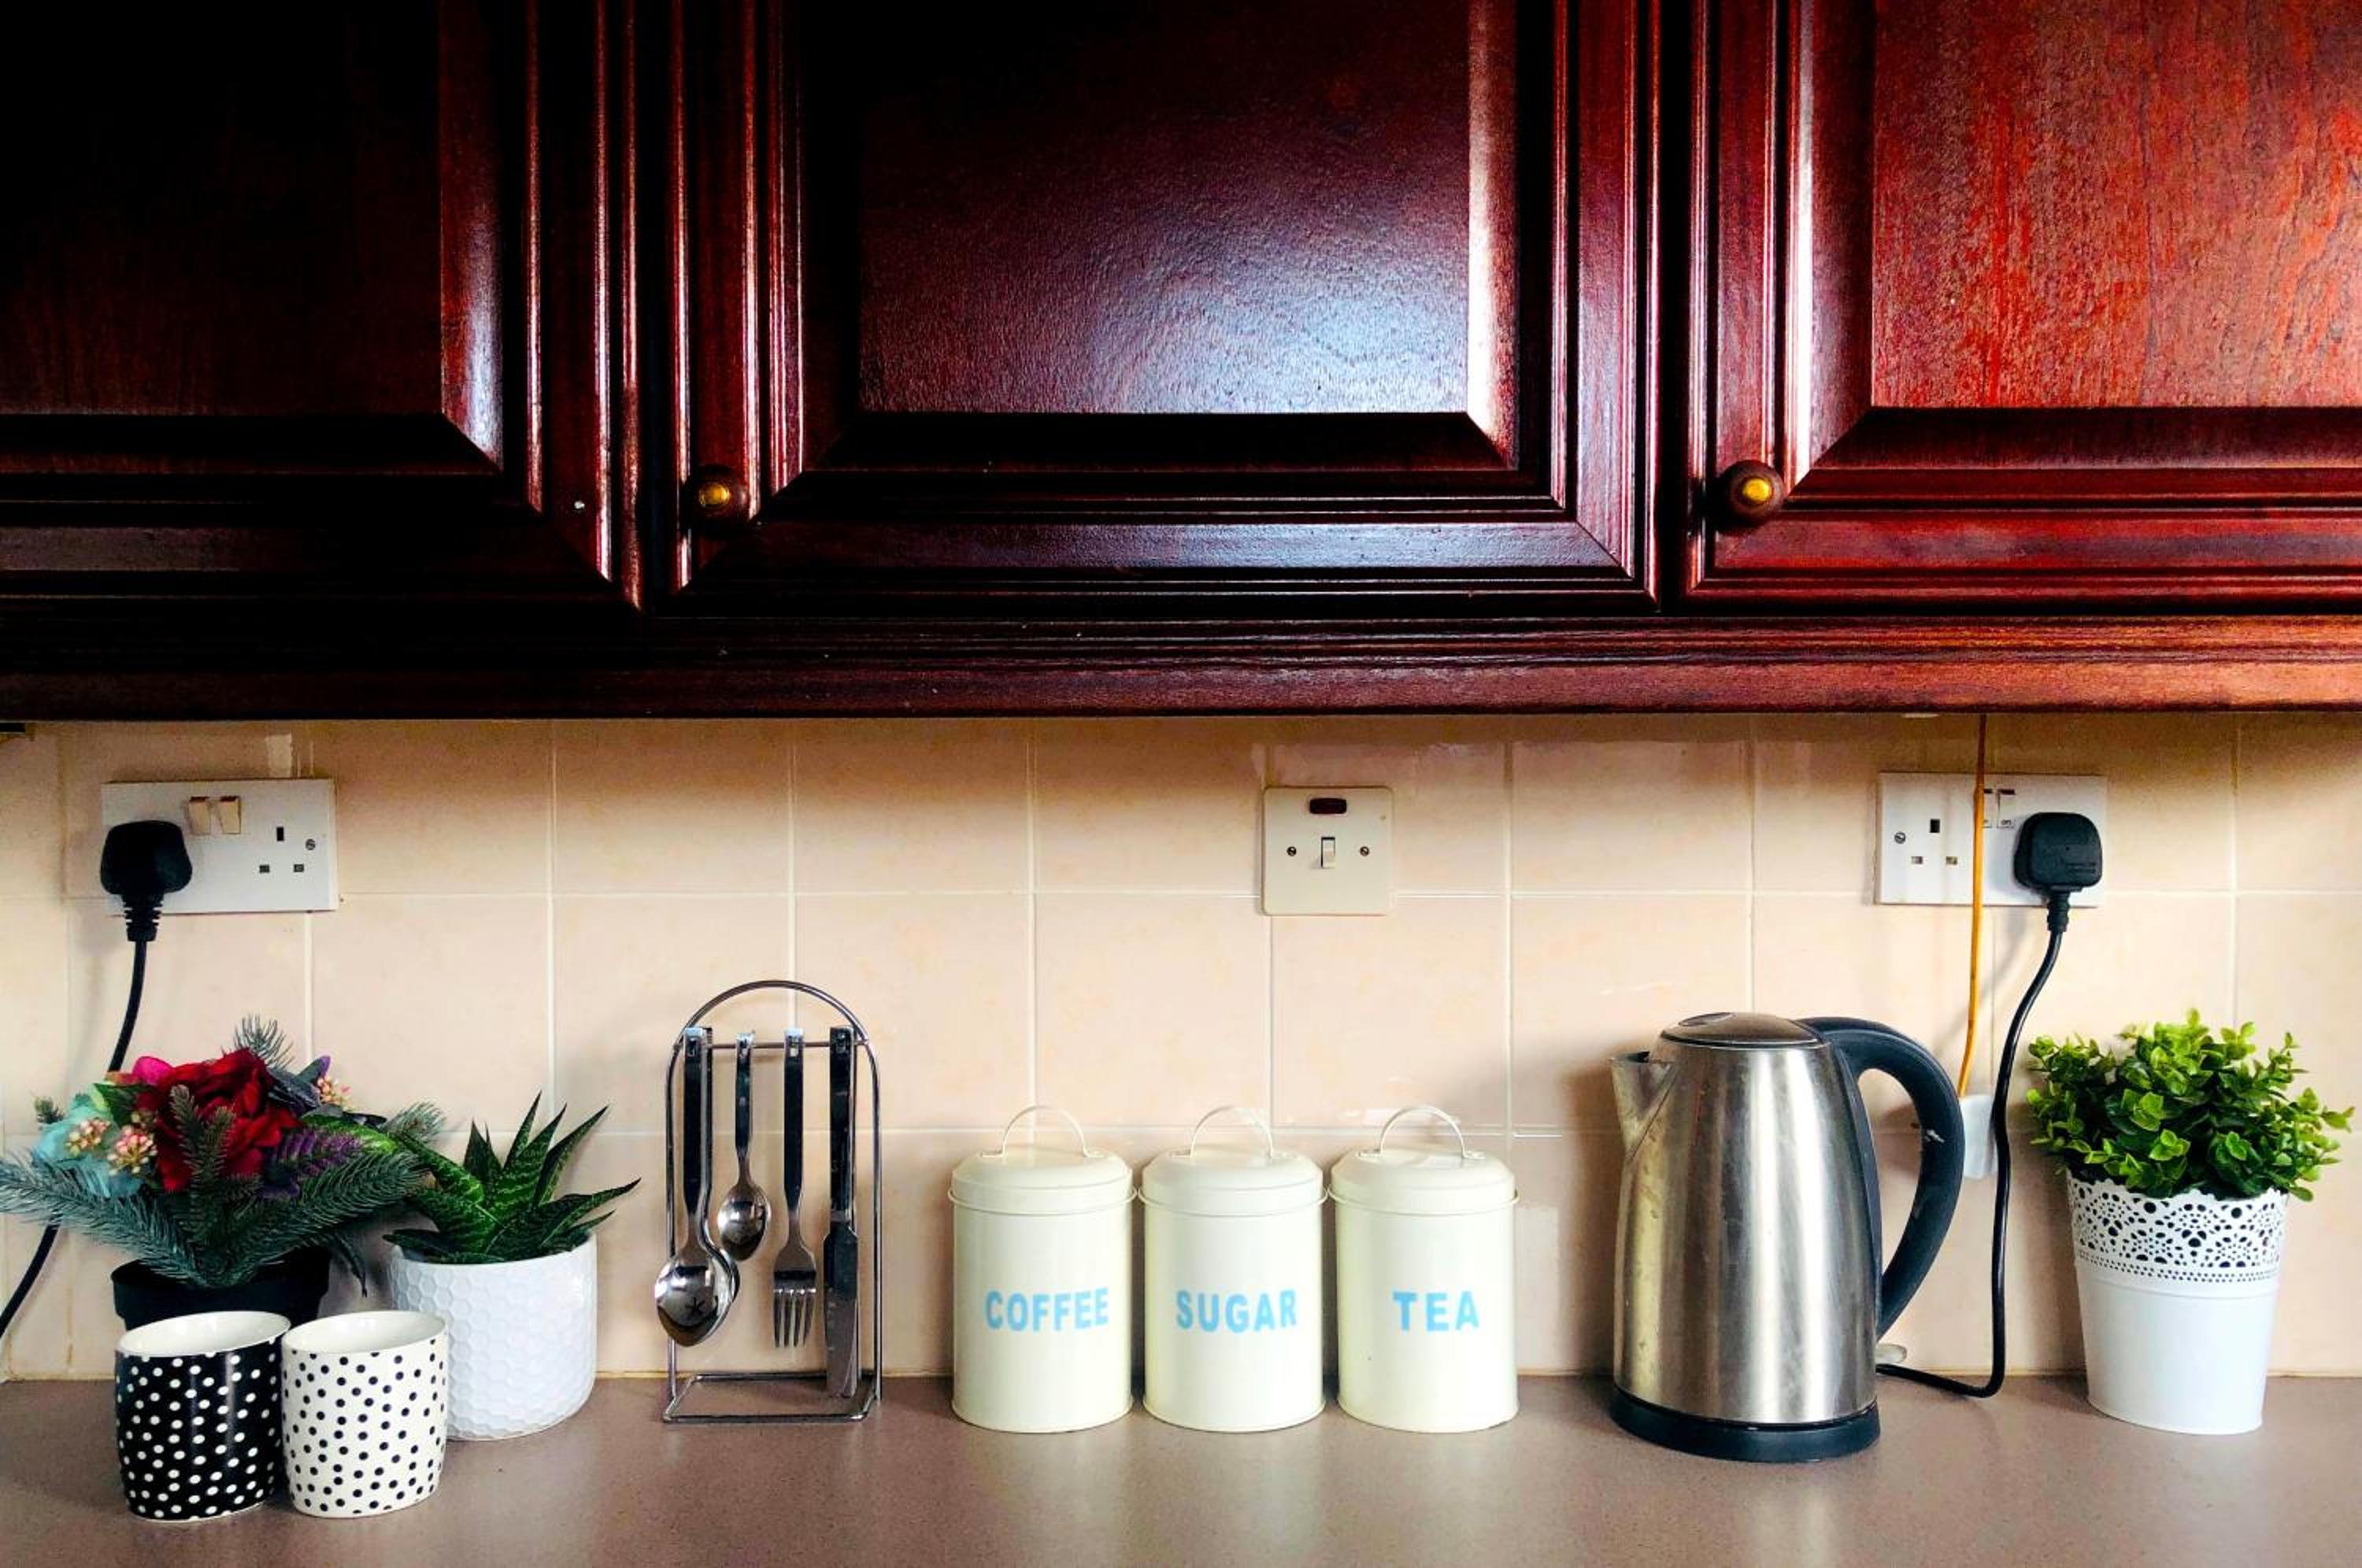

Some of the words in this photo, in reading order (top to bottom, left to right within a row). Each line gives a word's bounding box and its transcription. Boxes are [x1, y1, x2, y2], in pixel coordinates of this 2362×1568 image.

[986, 1288, 1109, 1331] COFFEE
[1176, 1290, 1298, 1333] SUGAR
[1392, 1291, 1479, 1331] TEA
